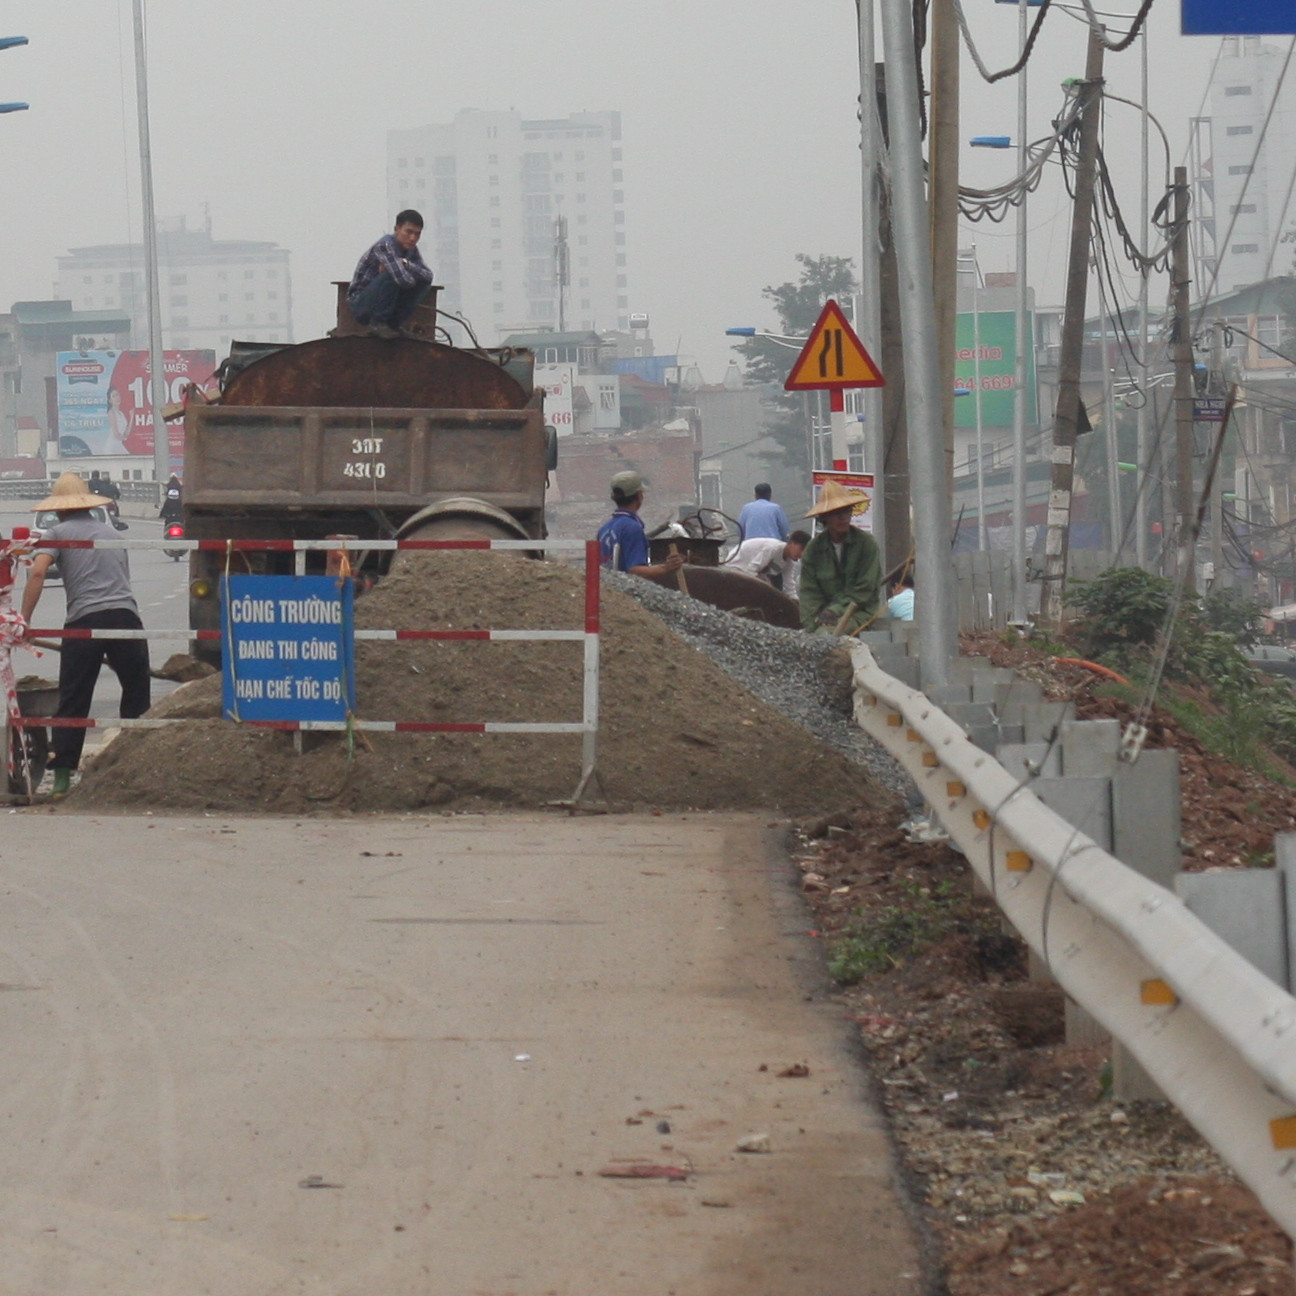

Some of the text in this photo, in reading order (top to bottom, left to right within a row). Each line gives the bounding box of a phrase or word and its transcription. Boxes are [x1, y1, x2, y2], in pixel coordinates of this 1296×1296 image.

[955, 345, 1002, 360] edia
[231, 594, 342, 623] CÔNG TRƯỜNG
[238, 637, 337, 661] ĐANG THI CÔNG
[236, 675, 341, 704] HẠN CHẾ TỐC ĐỘ
